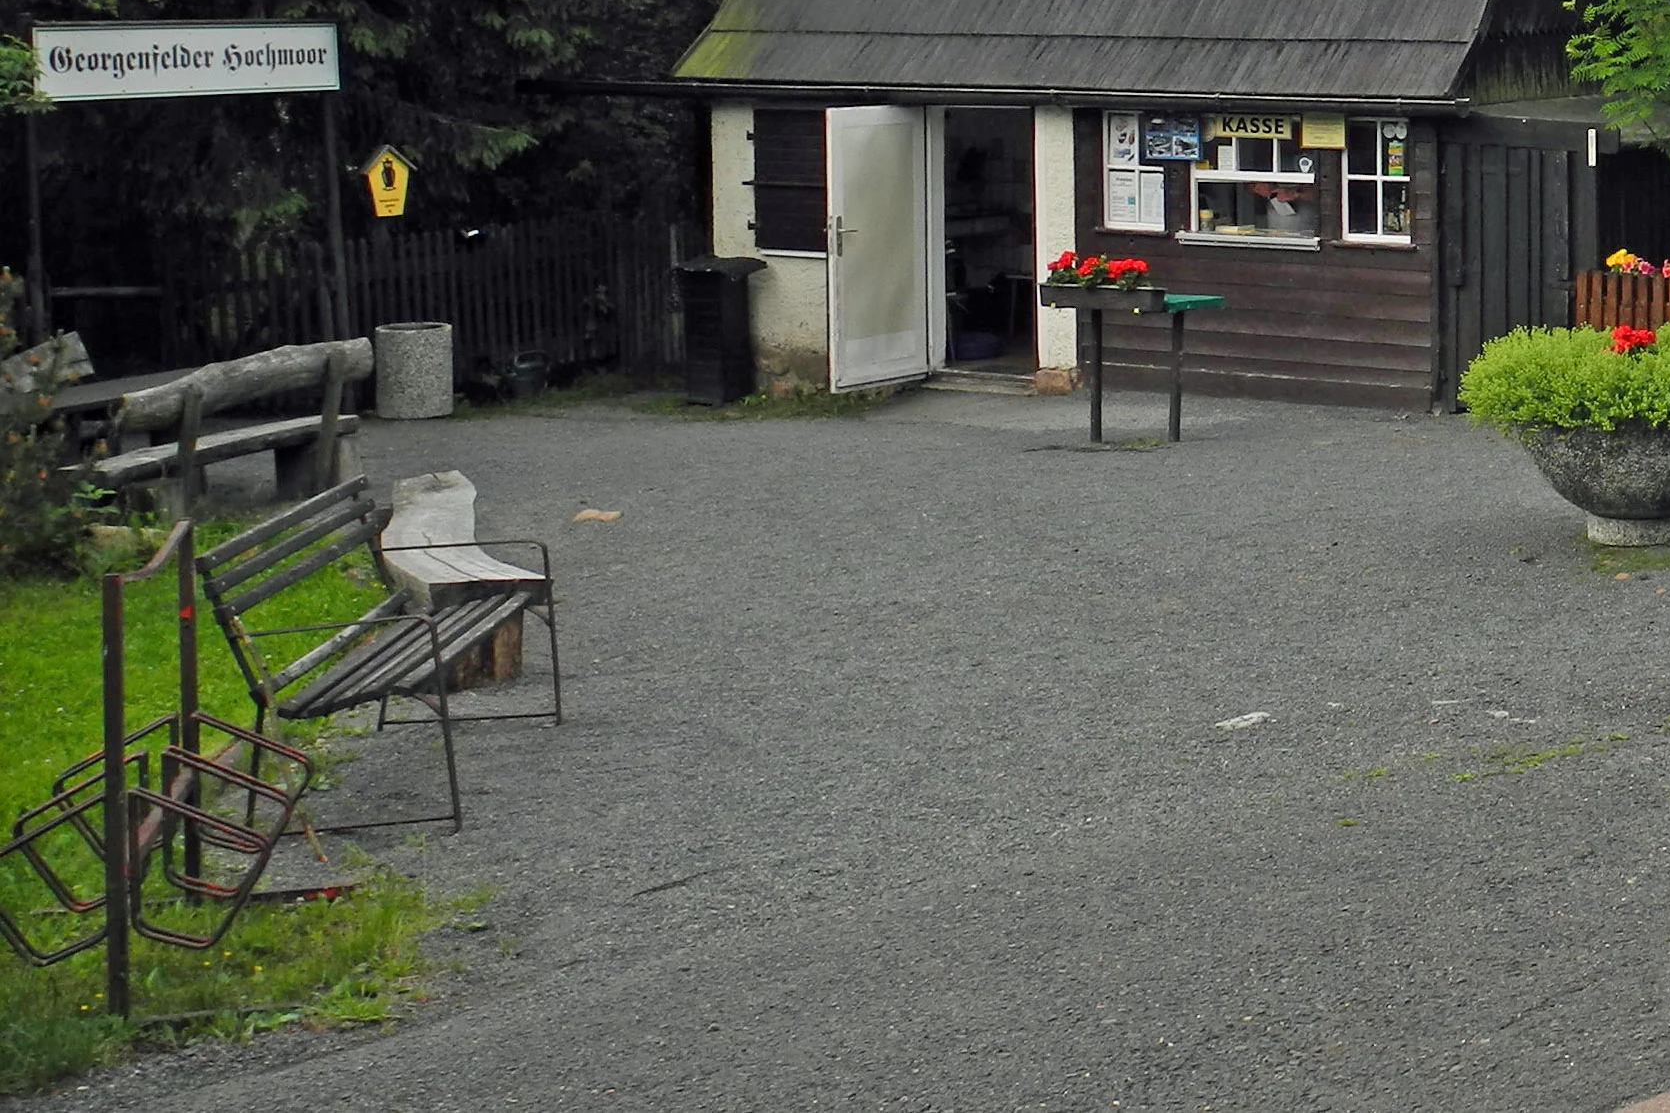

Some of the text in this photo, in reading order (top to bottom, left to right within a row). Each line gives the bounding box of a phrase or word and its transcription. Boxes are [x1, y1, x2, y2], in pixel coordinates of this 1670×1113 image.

[49, 42, 327, 79] Georgenfelder Hochmoor
[1222, 117, 1284, 134] KASSE
